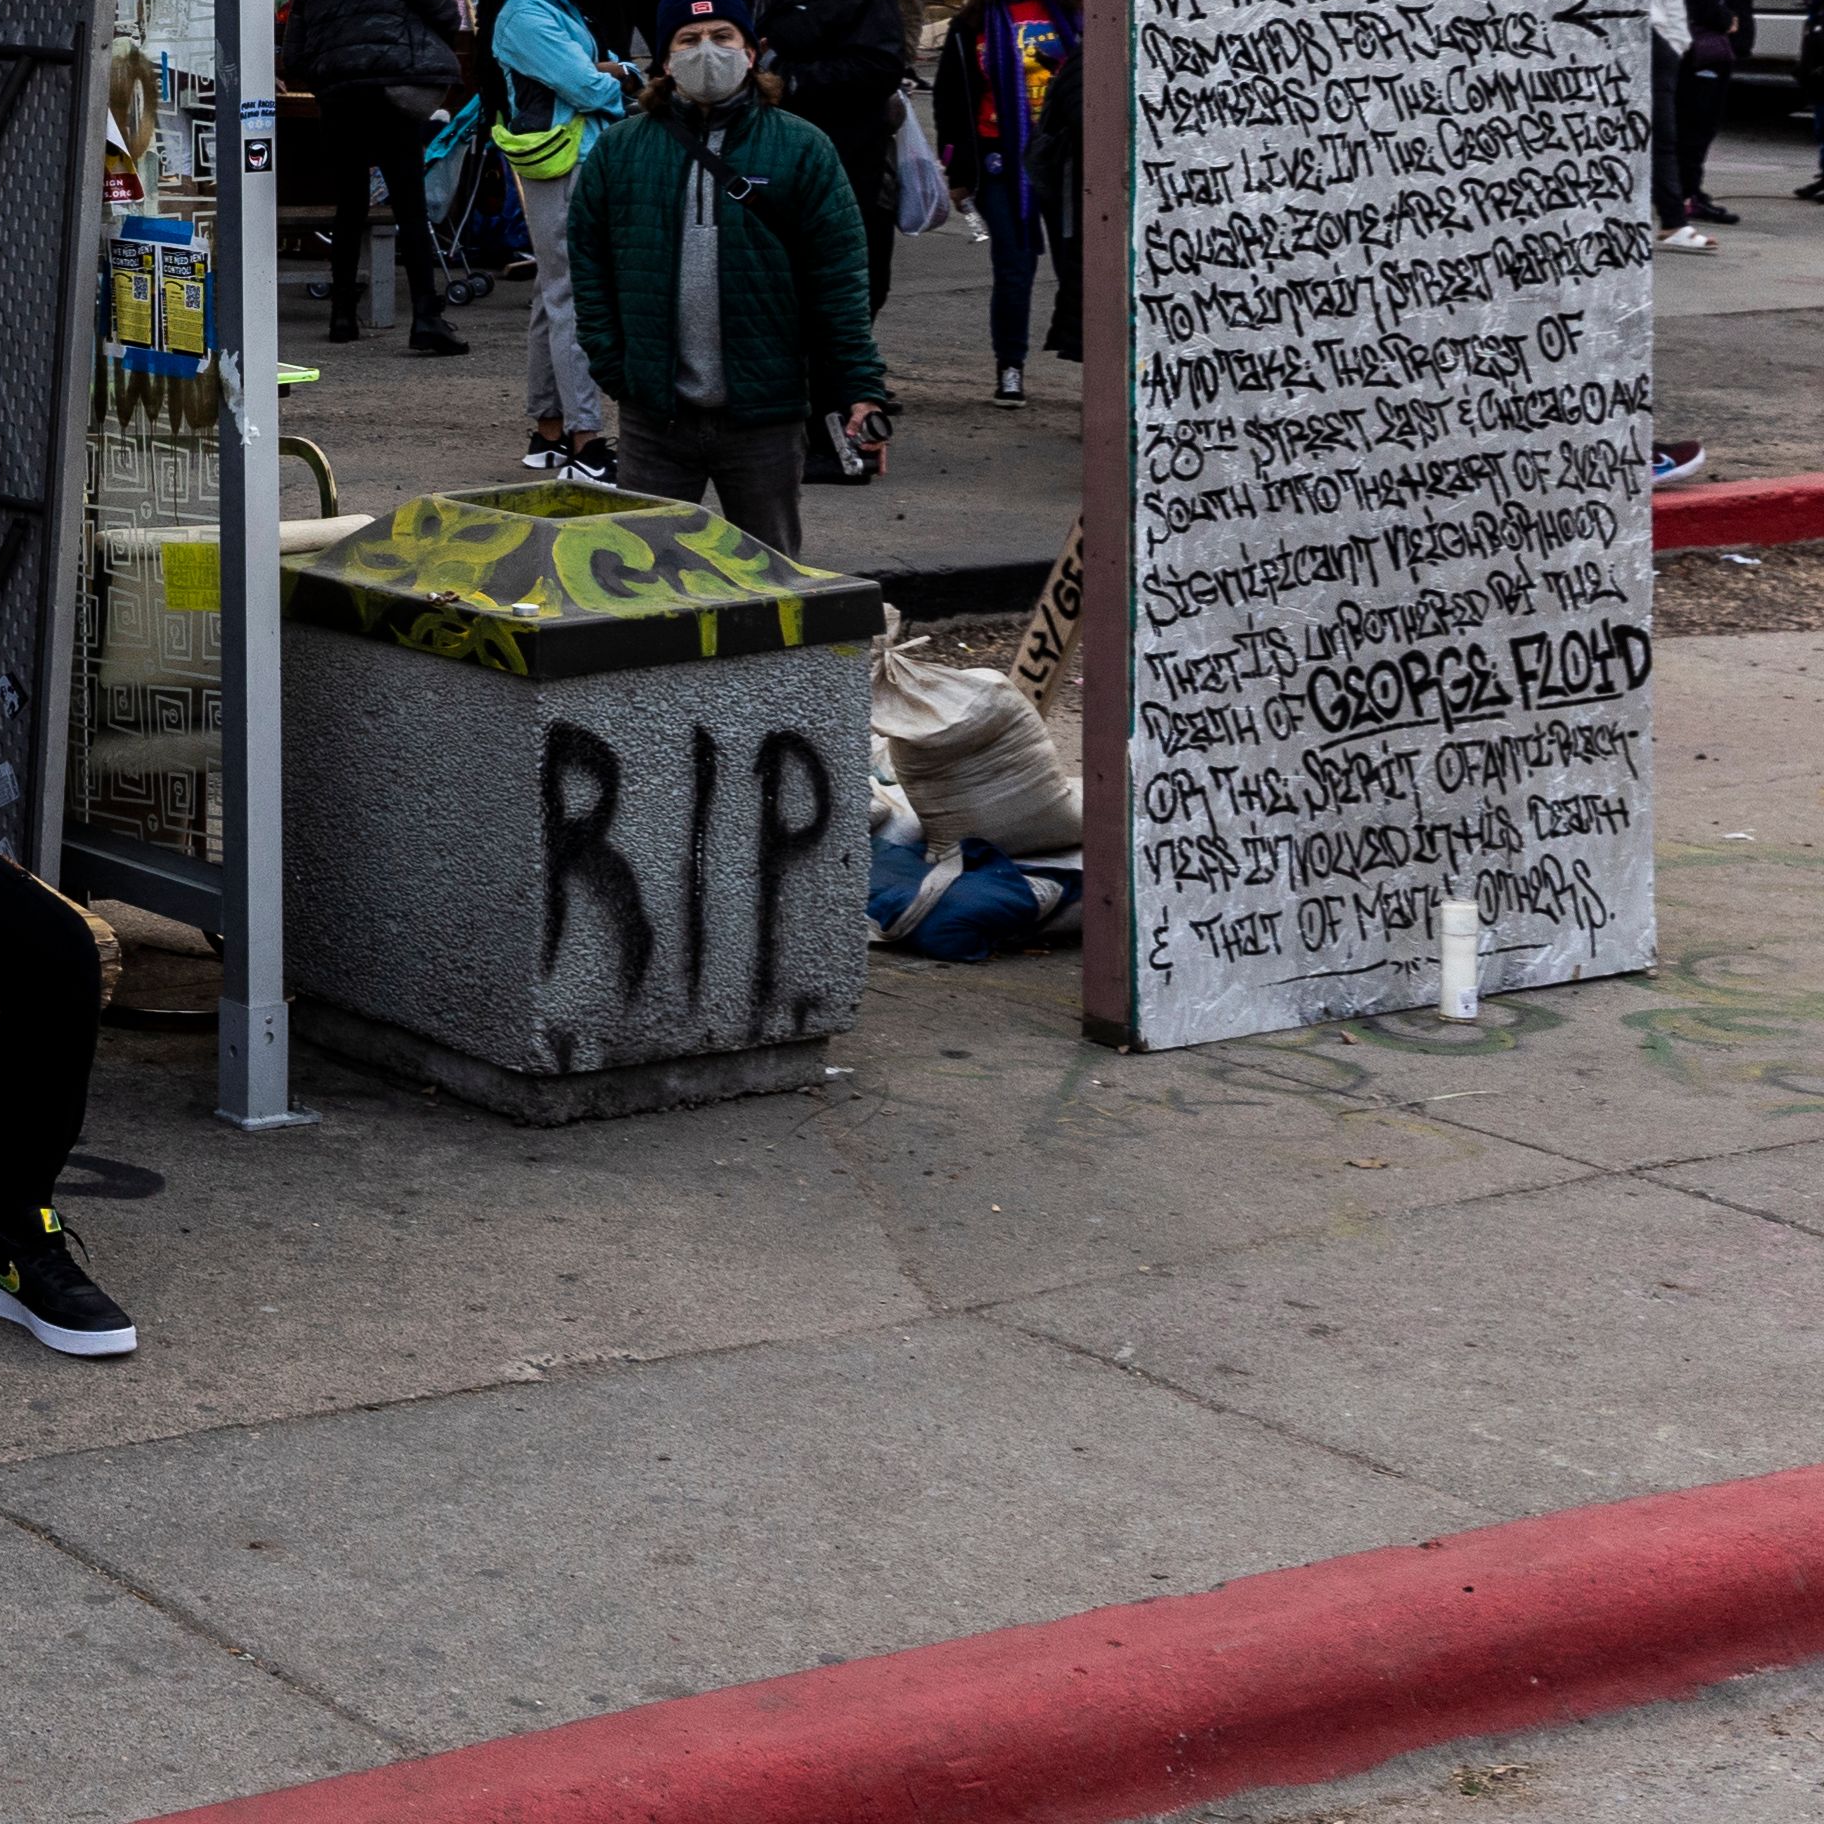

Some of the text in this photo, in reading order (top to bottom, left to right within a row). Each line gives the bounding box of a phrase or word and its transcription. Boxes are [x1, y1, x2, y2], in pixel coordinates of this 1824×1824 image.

[1308, 623, 1651, 732] GEORGE FLOYD
[542, 721, 832, 1036] RIP
